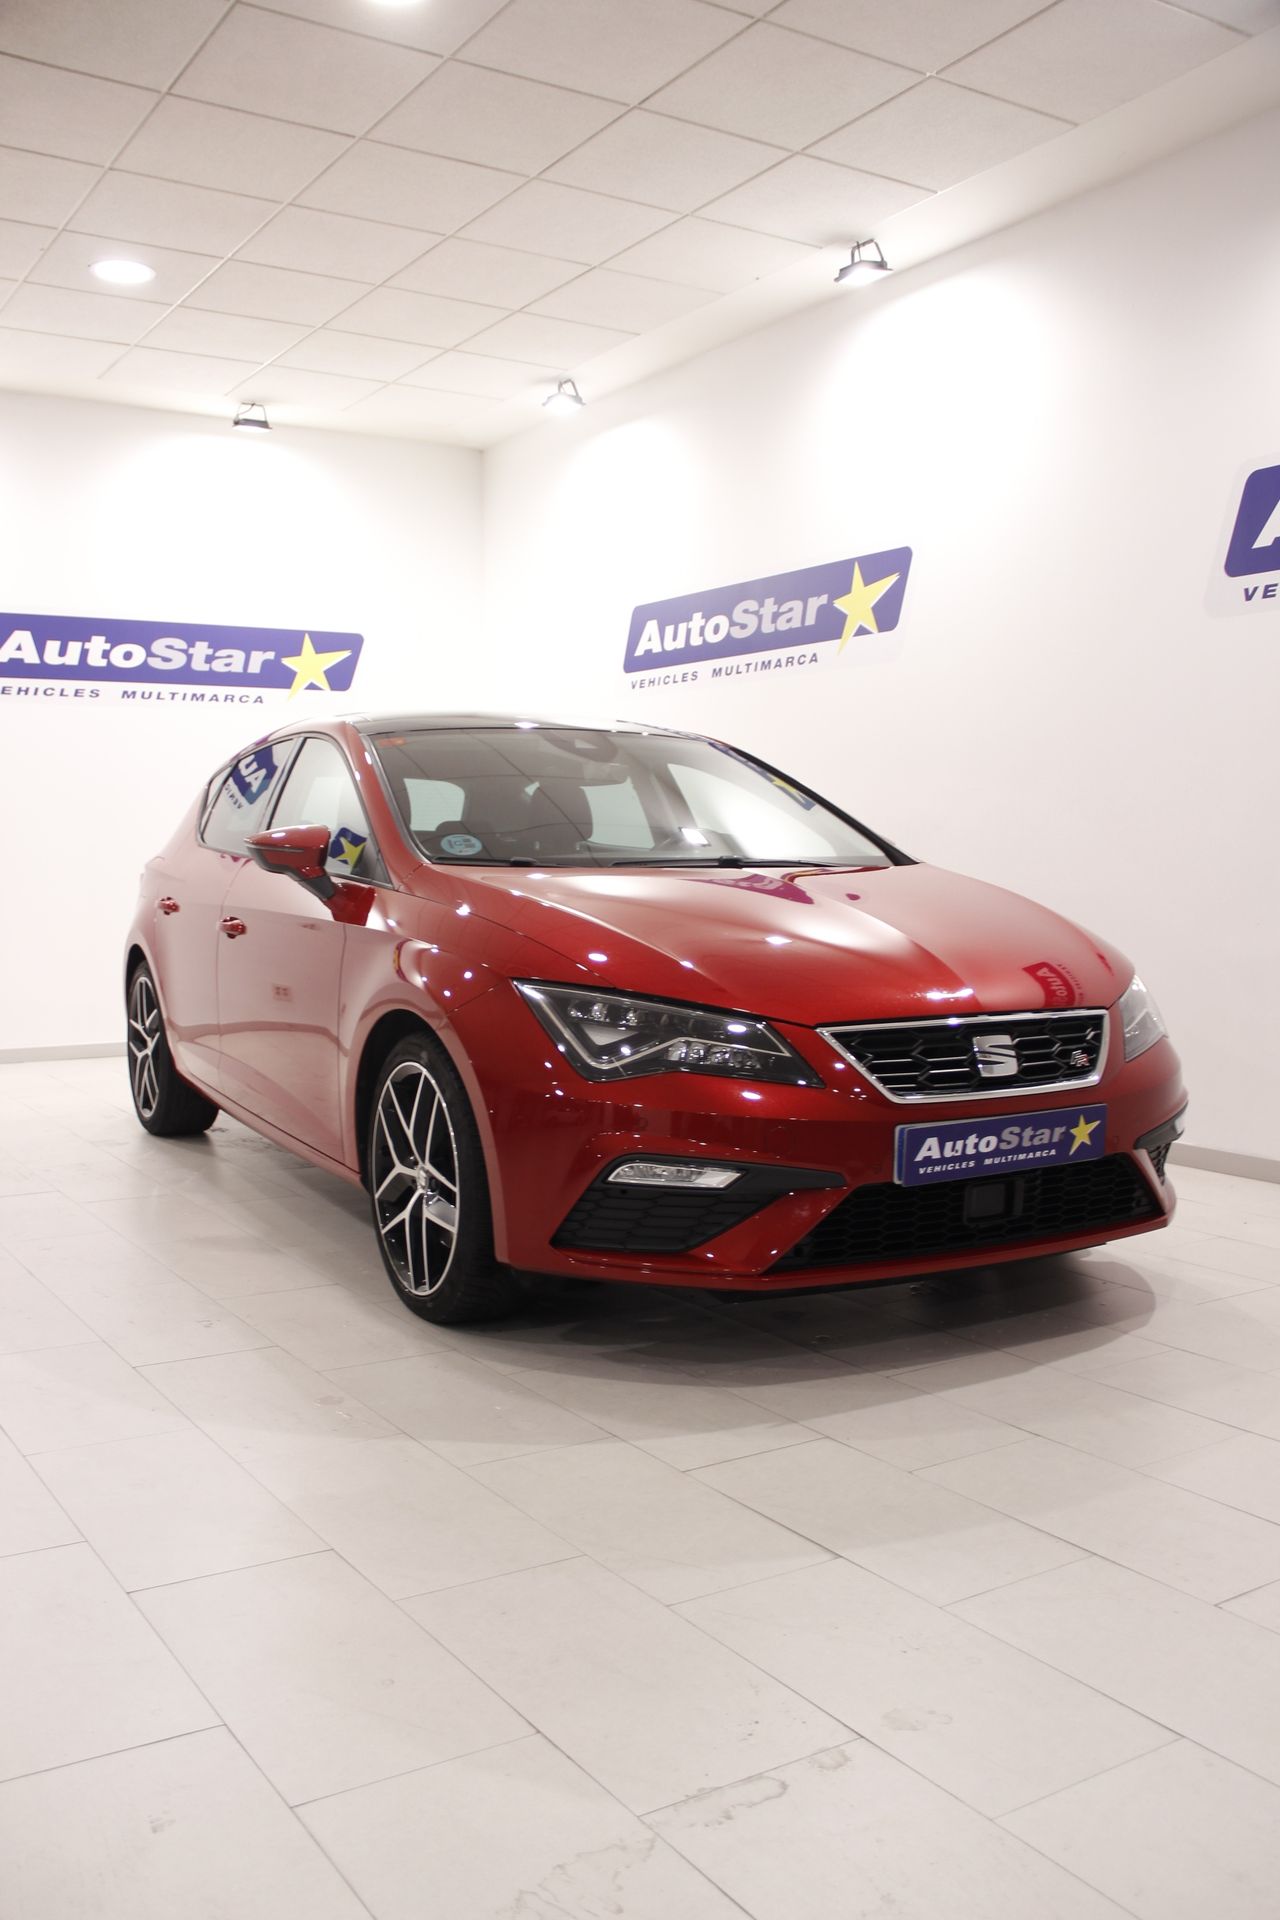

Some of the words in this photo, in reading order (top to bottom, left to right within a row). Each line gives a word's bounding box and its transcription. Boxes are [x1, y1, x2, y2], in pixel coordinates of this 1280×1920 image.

[634, 594, 828, 657] AutoStar
[0, 629, 275, 674] AutoStar
[631, 670, 699, 690] VEHICLES
[711, 652, 819, 678] MULTIMARCA
[0, 685, 101, 698] EHICLES
[121, 689, 265, 704] MULTIMARCA
[913, 1125, 1067, 1162] AutoStar
[918, 1160, 976, 1174] VEHICLES
[983, 1149, 1057, 1166] MULTIMARCA
